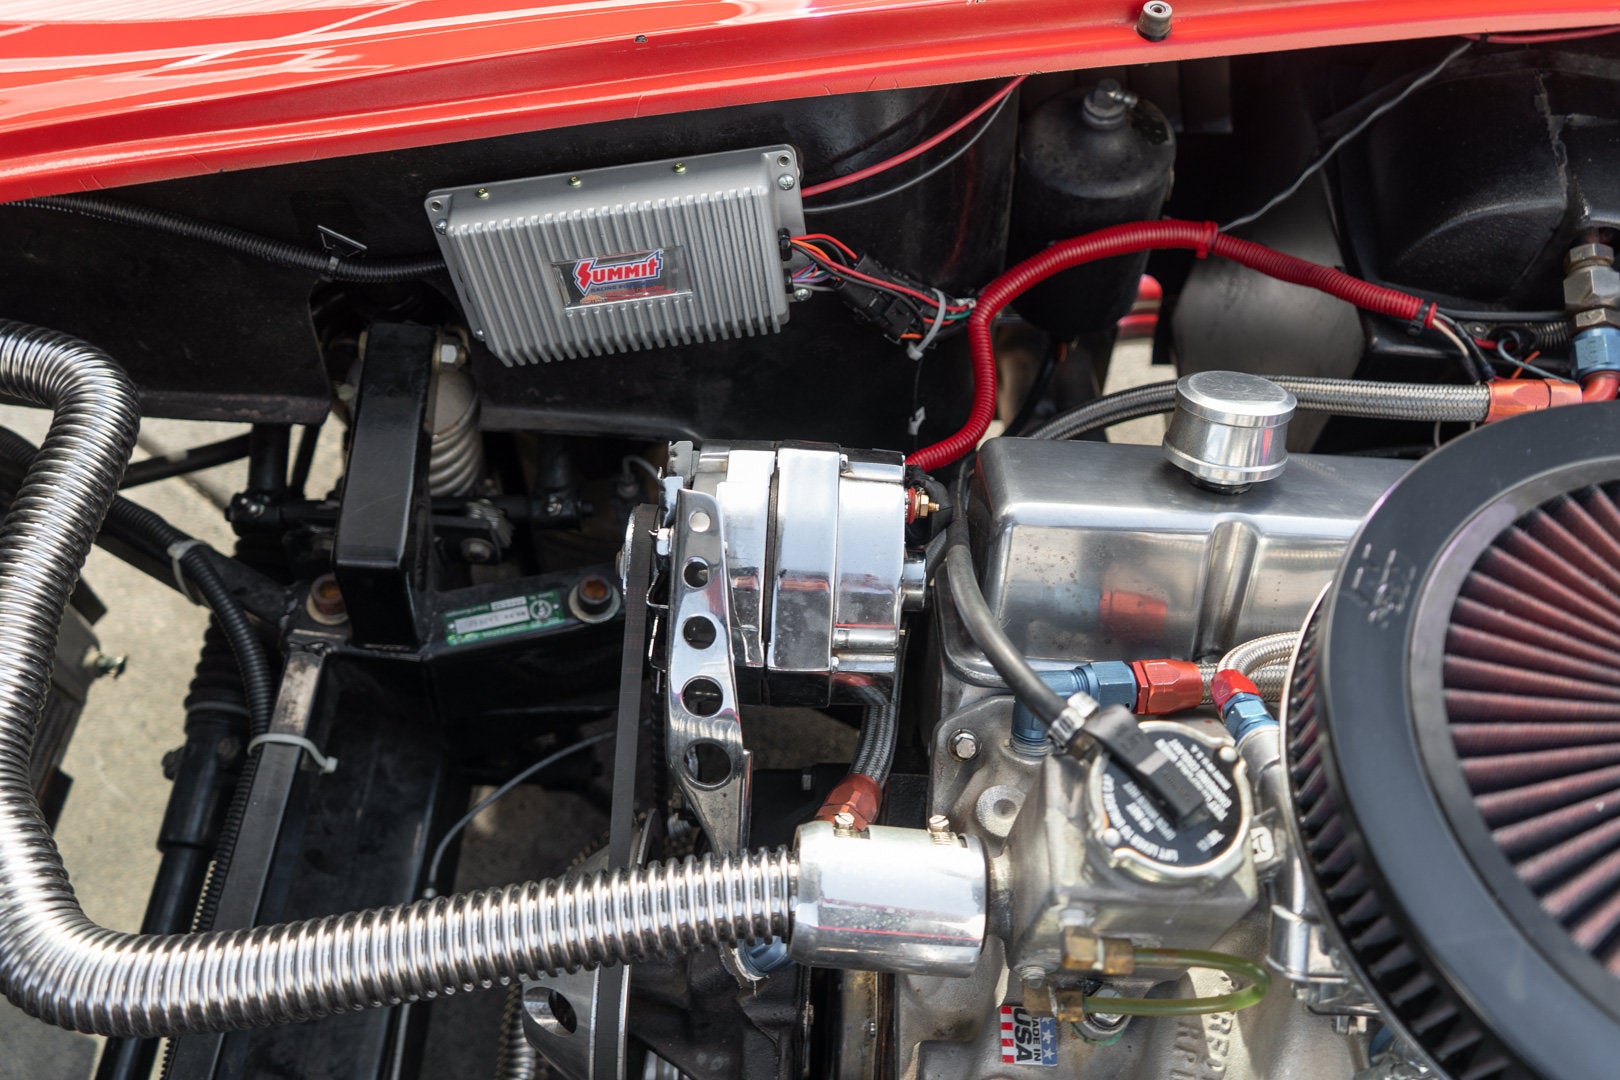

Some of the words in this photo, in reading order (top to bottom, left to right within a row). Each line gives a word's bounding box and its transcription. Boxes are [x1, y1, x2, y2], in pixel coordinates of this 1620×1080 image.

[1013, 1007, 1033, 1062] USA
[1031, 1016, 1041, 1045] ADE
[1033, 1048, 1042, 1062] IN
